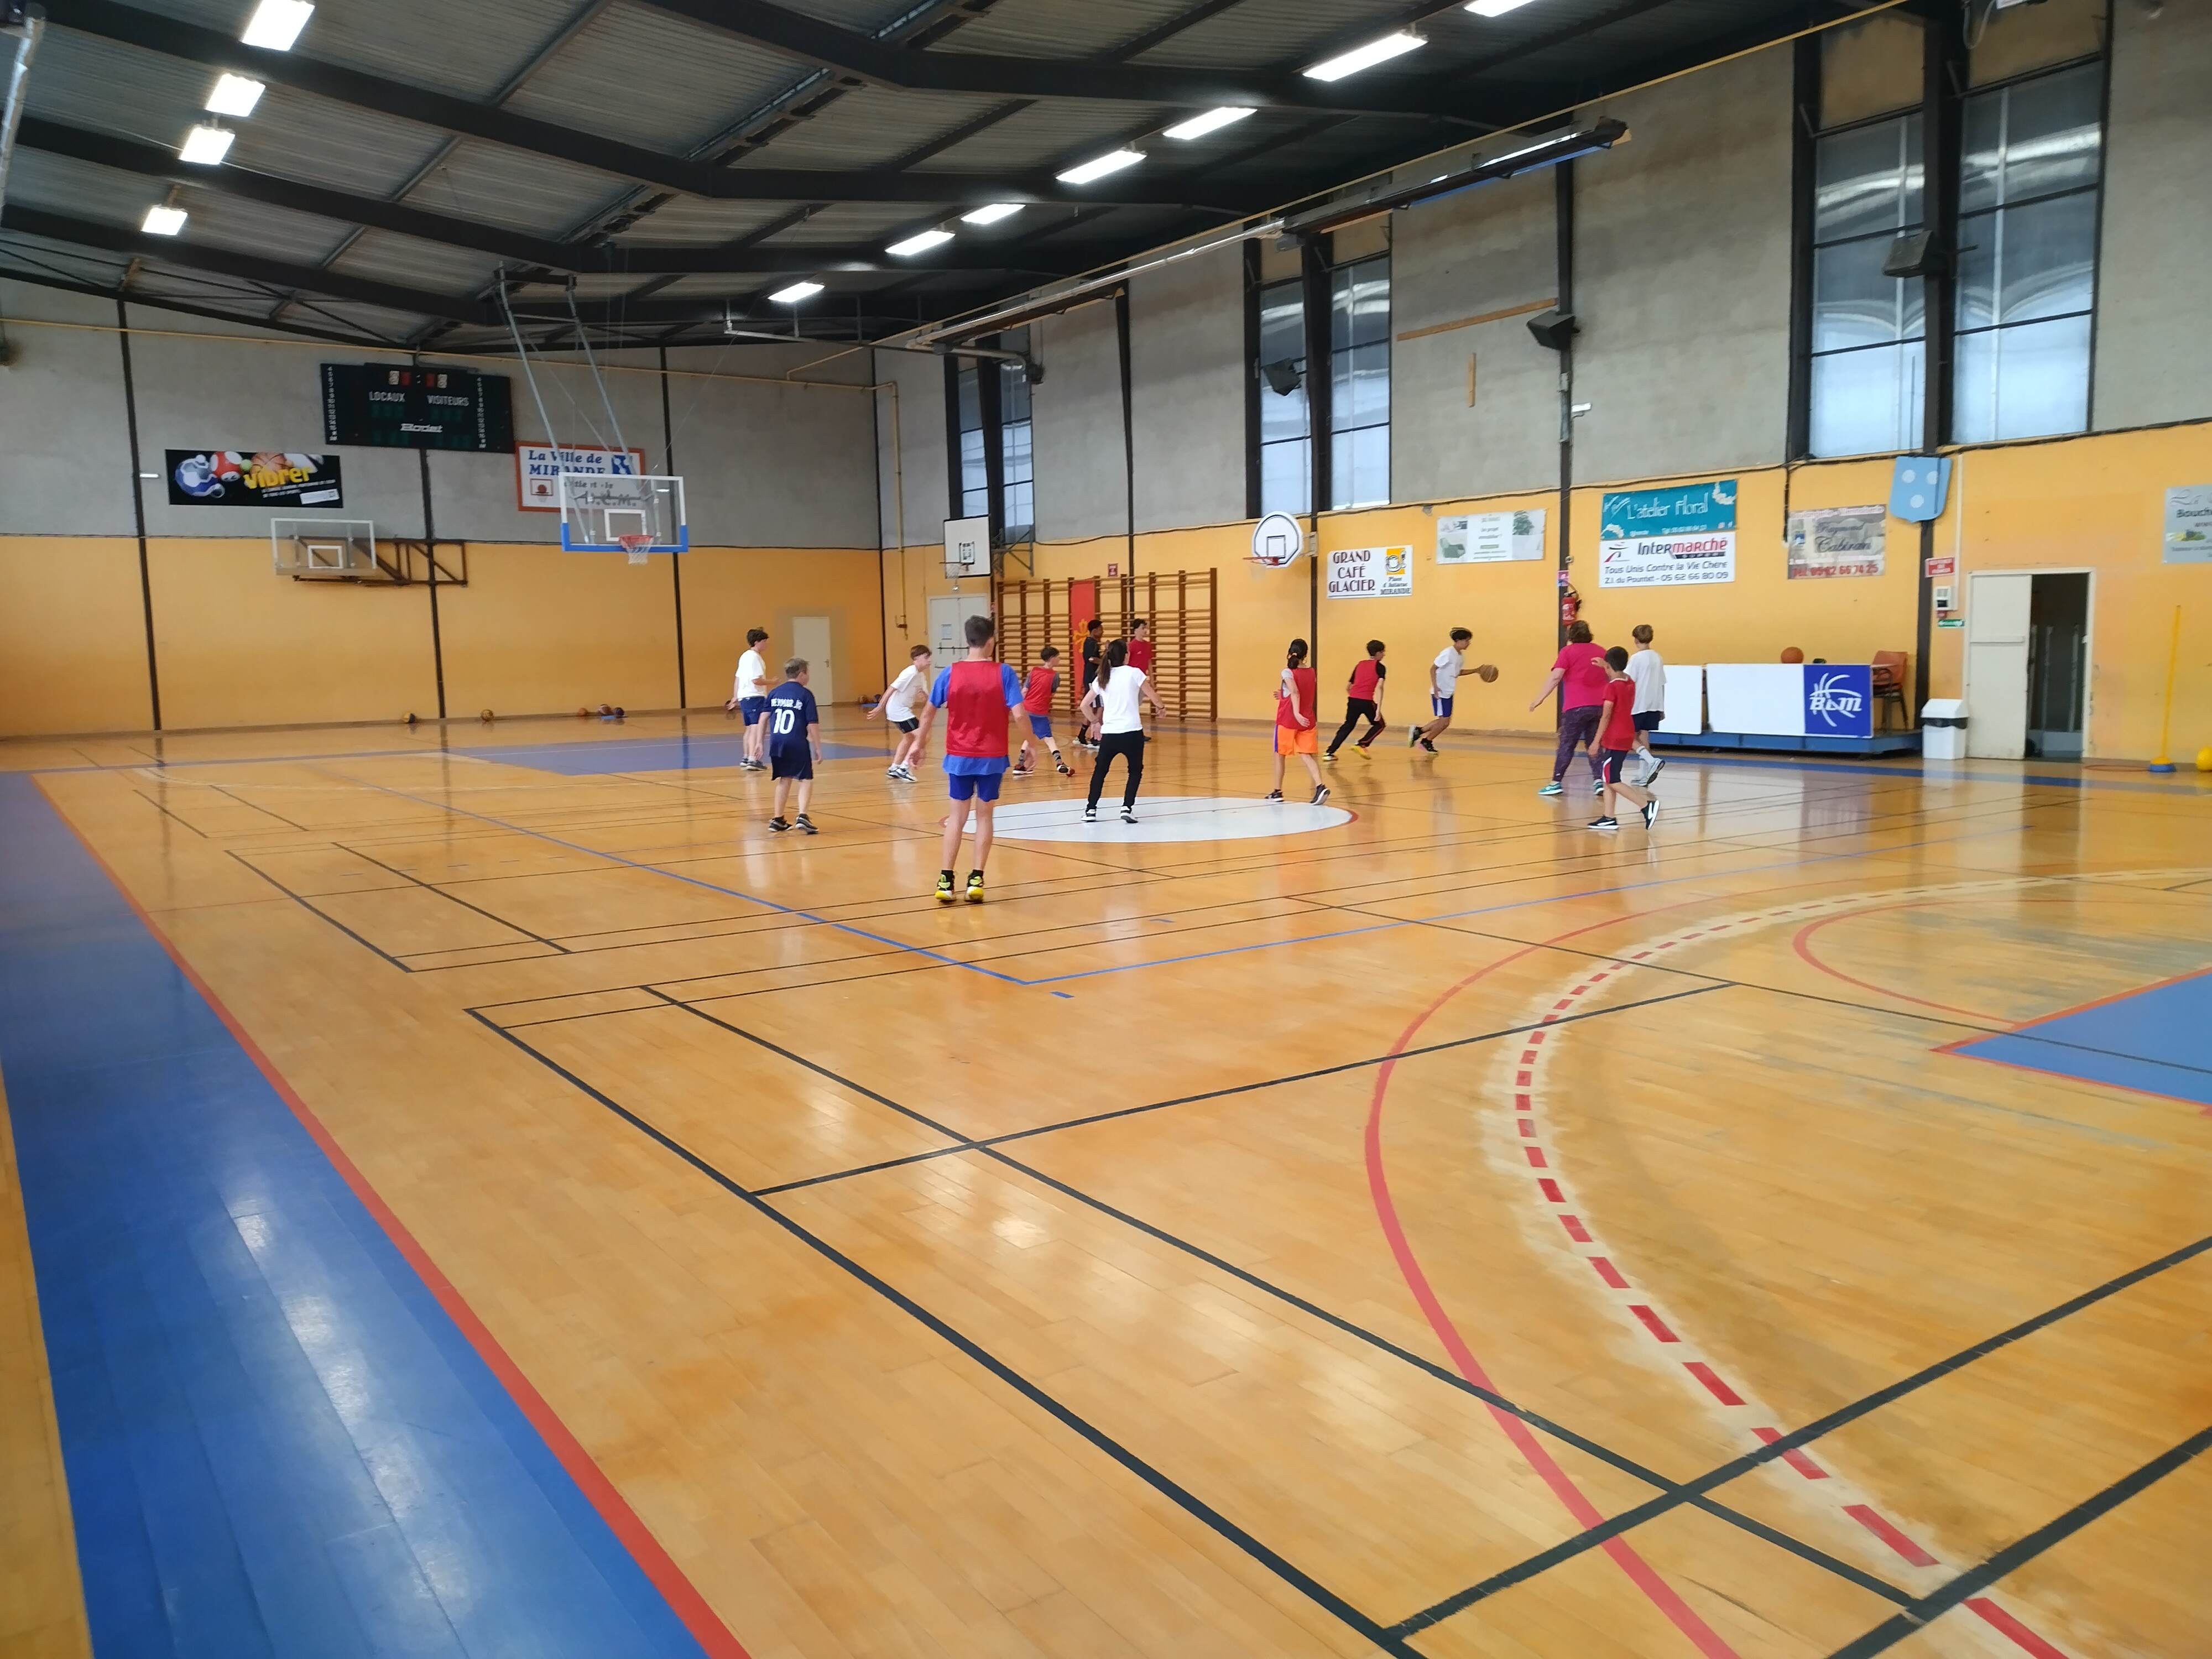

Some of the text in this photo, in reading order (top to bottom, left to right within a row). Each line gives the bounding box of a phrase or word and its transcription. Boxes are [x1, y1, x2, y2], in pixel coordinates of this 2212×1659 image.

[369, 390, 469, 407] LOCAUX VISITEURS
[528, 450, 546, 461] La
[587, 453, 603, 464] de
[1675, 492, 1709, 515] Floral
[1333, 550, 1371, 564] GRAND
[1338, 563, 1366, 578] CAFÉ
[1687, 562, 1700, 570] Vie
[1329, 579, 1376, 593] GLACIER
[773, 708, 795, 734] 10
